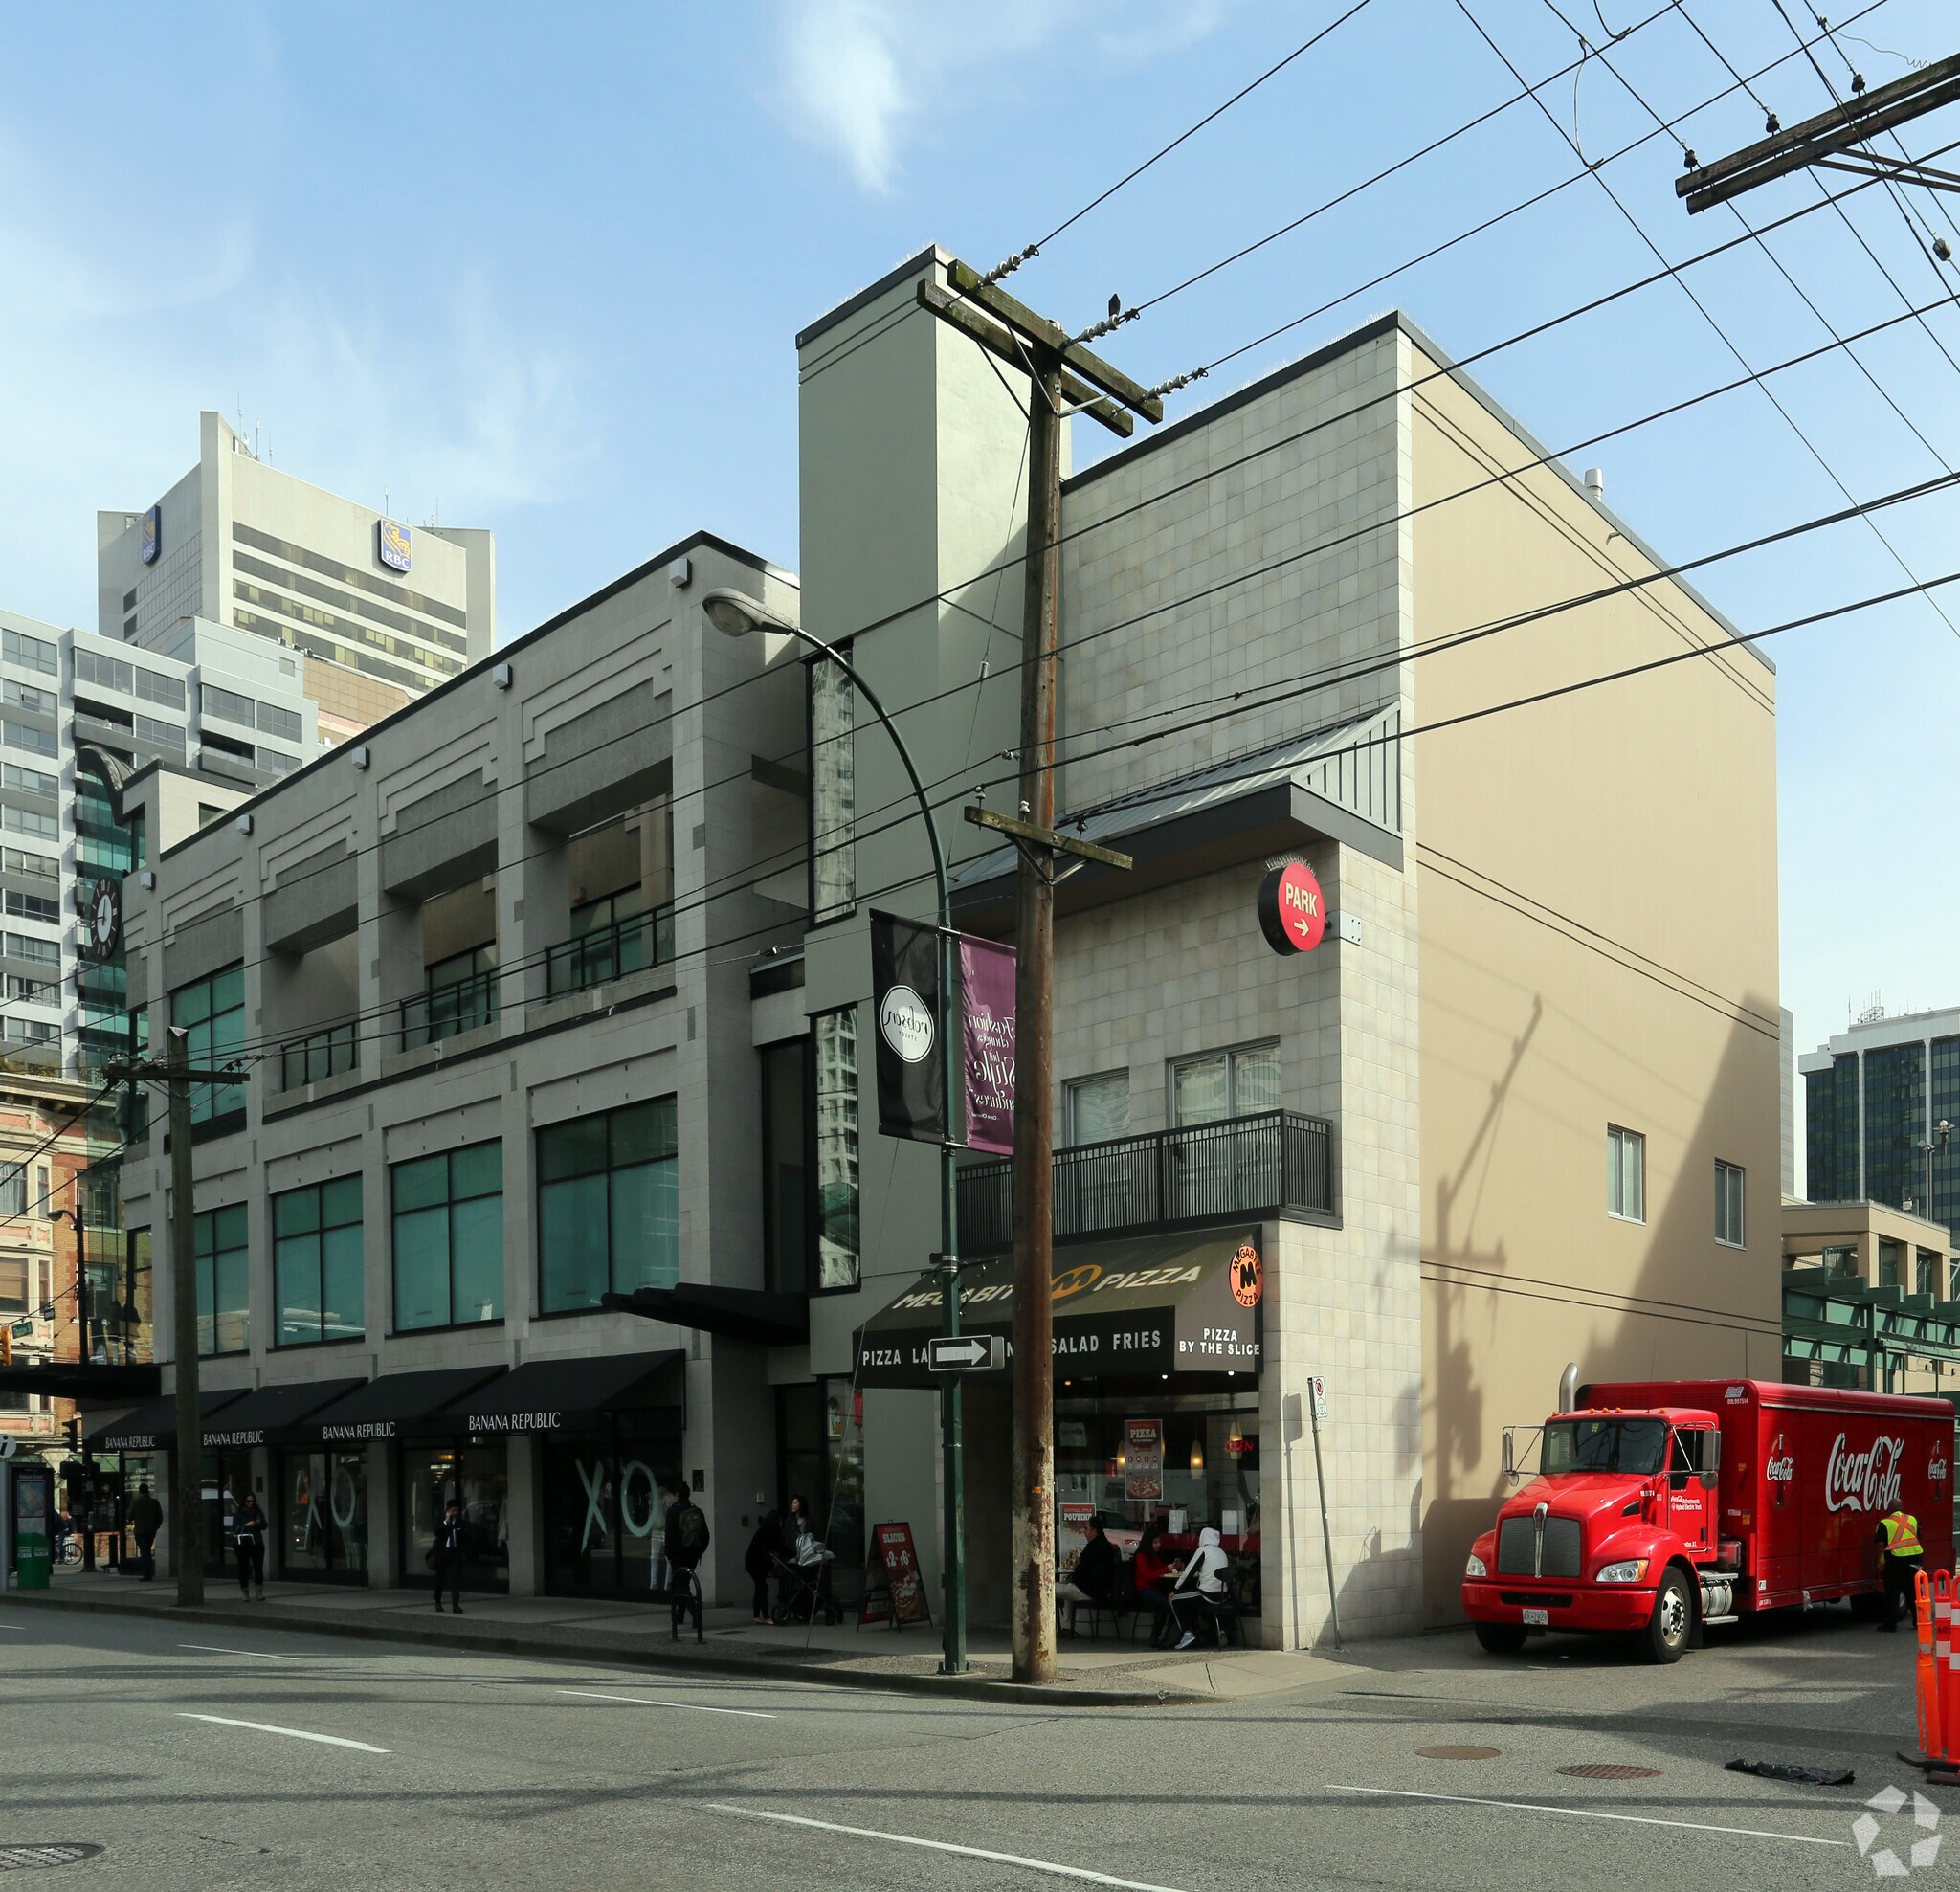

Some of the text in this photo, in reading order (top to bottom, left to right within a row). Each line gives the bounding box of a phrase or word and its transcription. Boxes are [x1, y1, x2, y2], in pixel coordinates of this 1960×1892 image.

[385, 550, 410, 568] RBC
[1286, 882, 1318, 917] PARK
[1092, 1266, 1201, 1292] PIZZA
[1240, 1261, 1257, 1289] M
[1236, 1289, 1258, 1305] PIZZA
[1204, 1328, 1237, 1342] PIZZA
[863, 1350, 902, 1366] PIZZA
[1113, 1330, 1160, 1350] FRIES
[1179, 1341, 1260, 1355] BY THE SLICE
[469, 1412, 561, 1431] BANANA REPUBLIC
[203, 1430, 264, 1446] BANANA REPUBLIC
[323, 1422, 396, 1439] BANANA REPUBLIC
[1129, 1429, 1157, 1438] PIZZA
[105, 1436, 156, 1449] BANANA REPUBLIC
[1225, 1439, 1254, 1453] OPEN
[1767, 1457, 1793, 1480] Coca-Cola
[1825, 1433, 1904, 1512] Coca-Cola
[1928, 1459, 1947, 1480] Coca-Cola
[882, 1532, 905, 1543] SLICES
